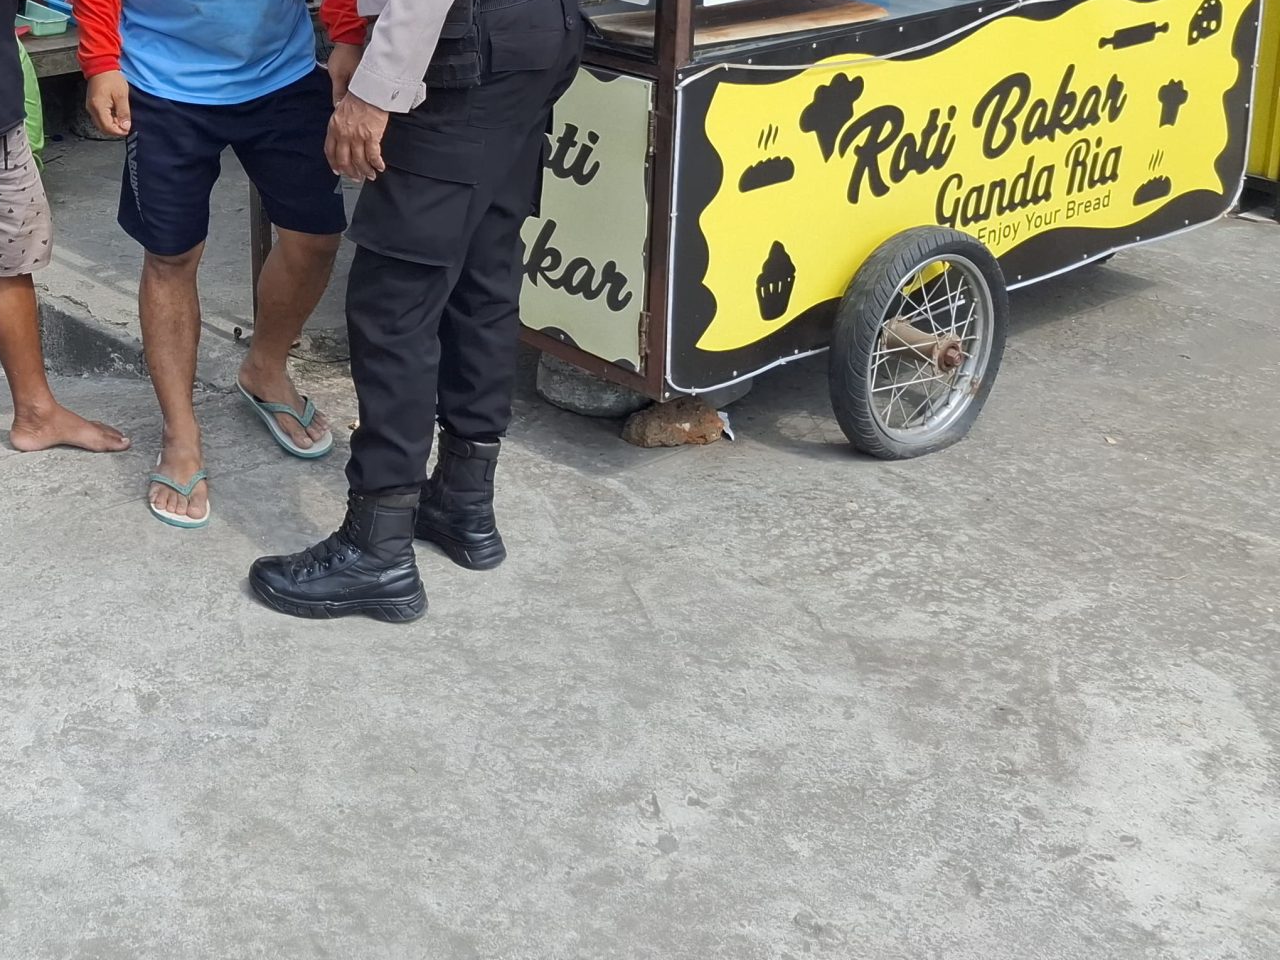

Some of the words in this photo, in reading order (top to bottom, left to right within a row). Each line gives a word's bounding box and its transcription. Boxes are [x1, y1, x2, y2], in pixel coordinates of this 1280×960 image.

[543, 122, 601, 186] ti
[838, 104, 957, 204] Roti
[972, 63, 1128, 159] Bakar
[935, 155, 1056, 229] Ganda
[1064, 136, 1123, 196] Ria
[977, 221, 1021, 246] Enjoy
[1025, 208, 1061, 232] Your
[1065, 190, 1111, 220] Bread
[522, 218, 633, 312] kar
